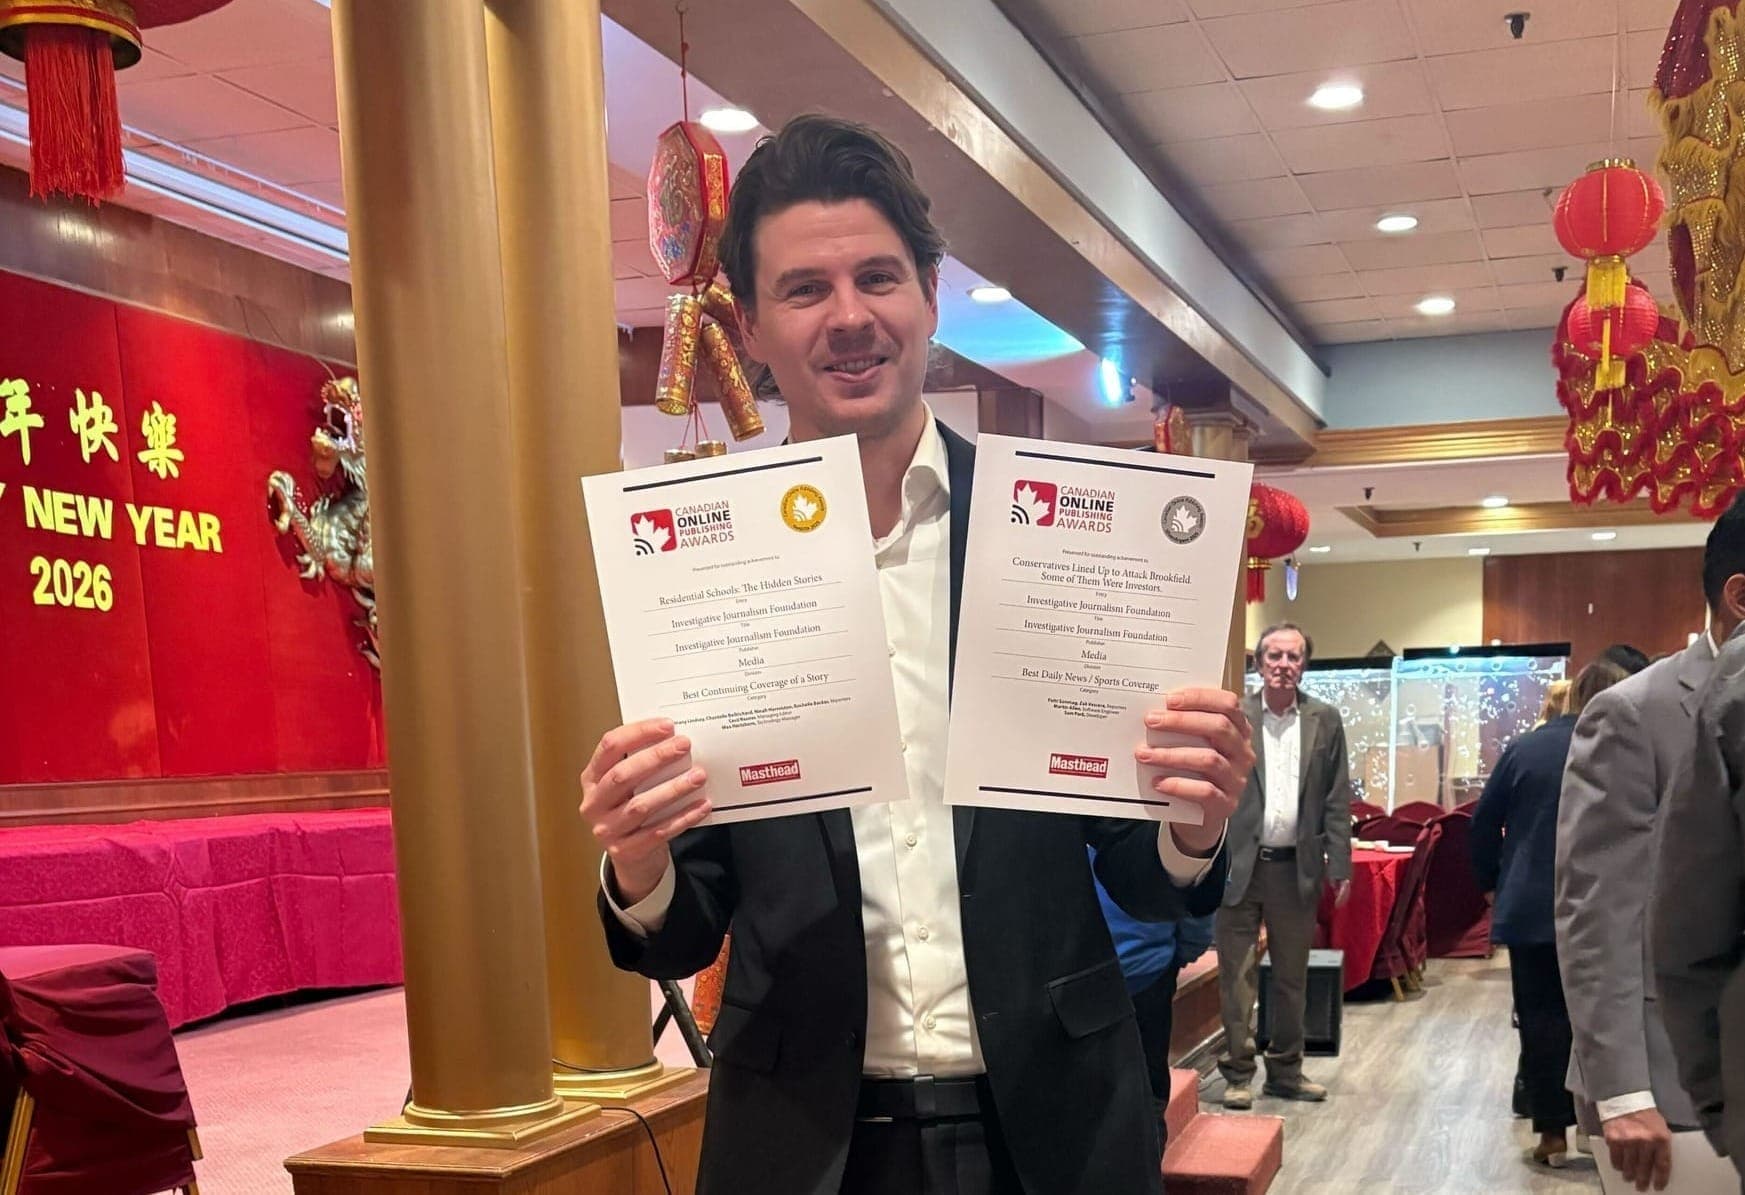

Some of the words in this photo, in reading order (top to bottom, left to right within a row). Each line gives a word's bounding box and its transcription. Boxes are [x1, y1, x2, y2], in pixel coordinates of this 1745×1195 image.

[1061, 486, 1115, 500] CANADIAN
[675, 501, 729, 516] CANADIAN
[1061, 497, 1114, 512] ONLINE
[23, 487, 114, 540] NEW
[127, 505, 223, 553] YEAR
[678, 510, 731, 527] ONLINE
[1060, 510, 1112, 521] PUBLISHING
[680, 522, 732, 536] PUBLISHING
[1056, 518, 1111, 533] AWARDS
[681, 531, 734, 549] AWARDS
[1013, 557, 1070, 572] Conservatives
[1072, 563, 1095, 573] Lined
[1098, 566, 1110, 578] Up
[1122, 569, 1147, 579] Attack
[31, 557, 114, 612] 2026
[659, 591, 704, 605] Residential
[742, 583, 758, 592] The
[760, 579, 791, 590] Hidden
[794, 575, 822, 584] Stories
[1041, 572, 1064, 583] Some
[1066, 575, 1076, 583] of
[1077, 576, 1100, 586] Them
[1103, 577, 1123, 588] Were
[1126, 581, 1161, 592] Investors.
[672, 616, 721, 628] Investigative
[723, 608, 768, 621] Journalism
[770, 601, 817, 613] Foundation
[1027, 595, 1077, 609] Investigative
[1079, 601, 1123, 613] Journalism
[1126, 606, 1170, 618] Foundation
[676, 639, 725, 652] Investigative
[727, 632, 771, 645] Journalism
[774, 626, 821, 637] Foundation
[1025, 620, 1074, 633] Investigative
[1077, 625, 1120, 637] Journalism
[1123, 630, 1167, 642] Foundation
[739, 657, 764, 667] Media
[1081, 650, 1106, 660] Media
[683, 691, 699, 700] Best
[701, 685, 749, 696] Continuing
[750, 680, 788, 690] Coverage
[790, 675, 798, 684] of
[807, 674, 829, 682] Story
[1022, 669, 1039, 678] Best
[1042, 670, 1063, 681] Daily
[1065, 673, 1087, 682] News
[1089, 675, 1093, 683] /
[1095, 675, 1119, 687] Sports
[1122, 679, 1159, 691] Coverage
[741, 763, 798, 781] Masthead
[1051, 756, 1106, 772] Masthead
